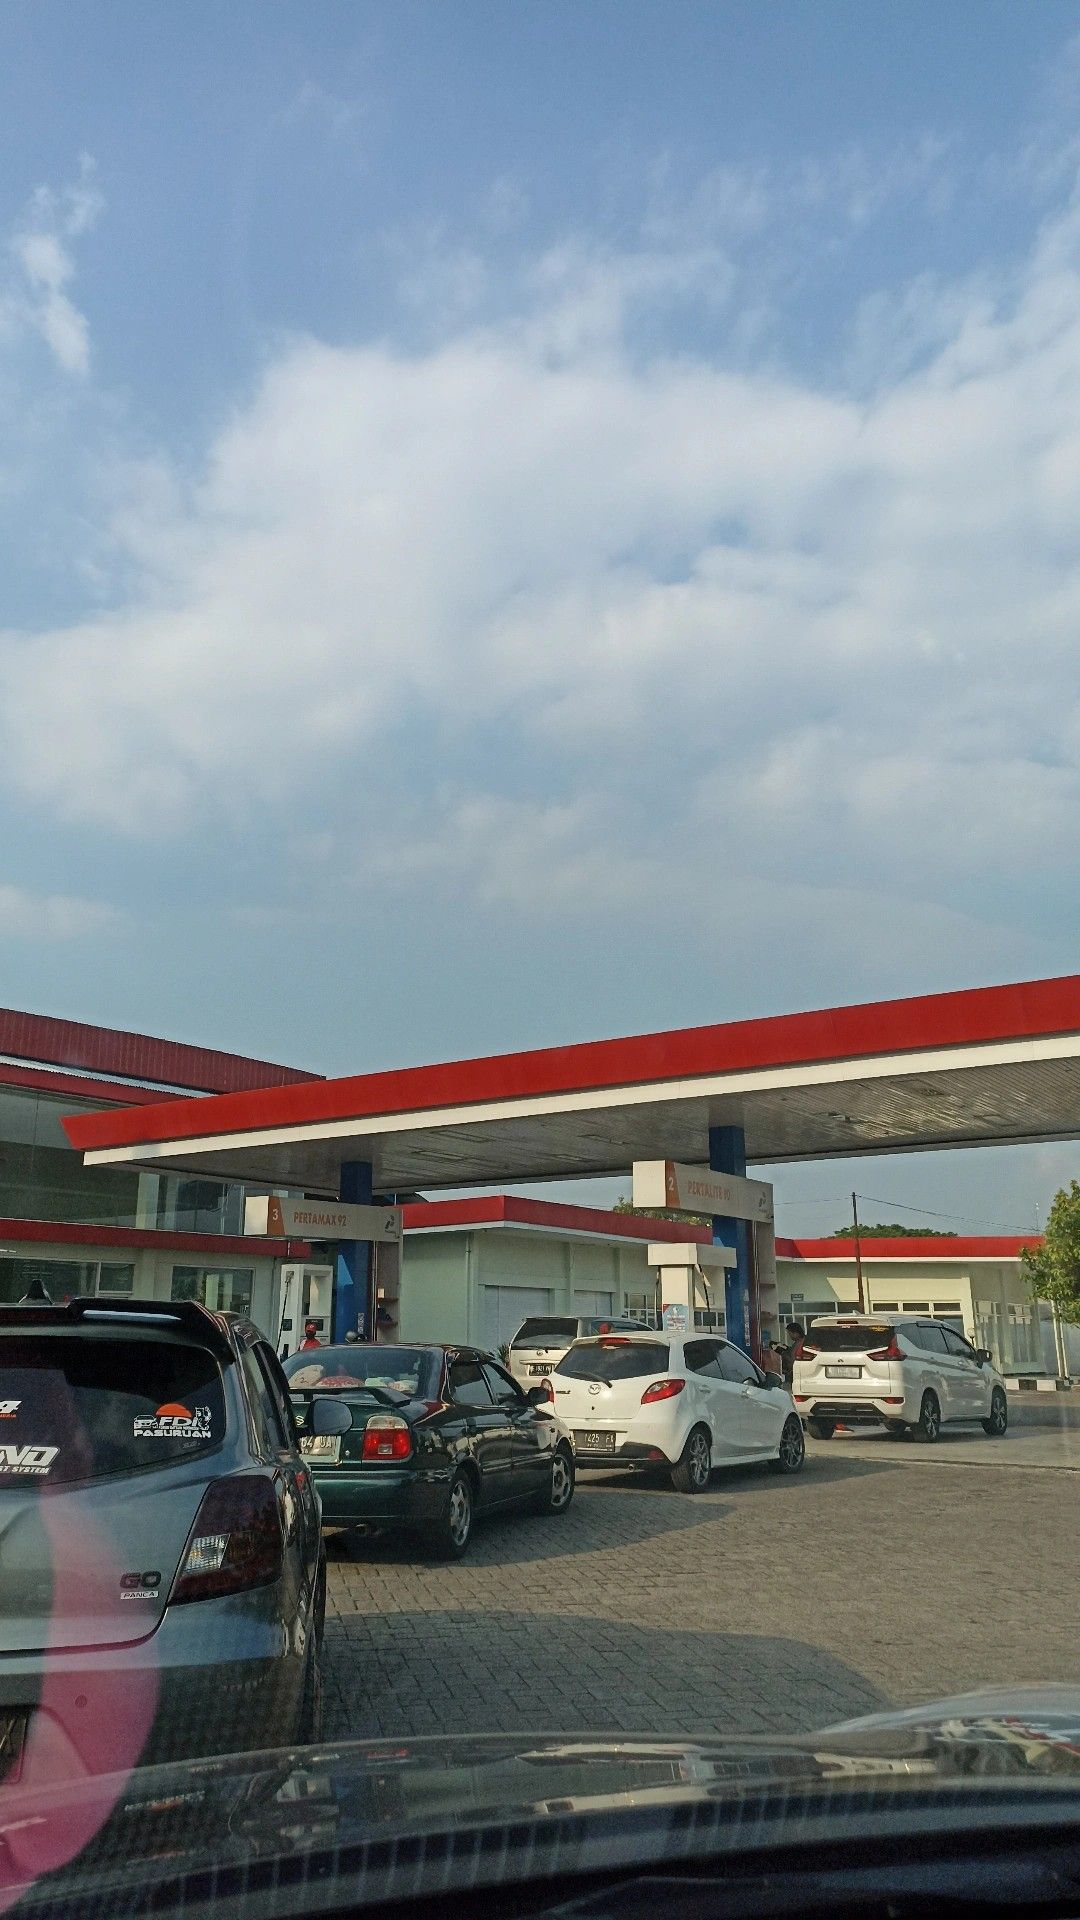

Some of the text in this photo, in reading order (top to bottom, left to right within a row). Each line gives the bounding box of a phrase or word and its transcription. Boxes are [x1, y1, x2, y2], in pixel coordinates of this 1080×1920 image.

[668, 1177, 675, 1191] 2
[687, 1180, 722, 1200] PERTALITE
[272, 1209, 279, 1221] 3
[293, 1211, 347, 1227] PERTAMAX 92
[133, 1429, 211, 1438] PASURUAN
[12, 1466, 50, 1474] SYSTEM
[120, 1571, 161, 1589] GO
